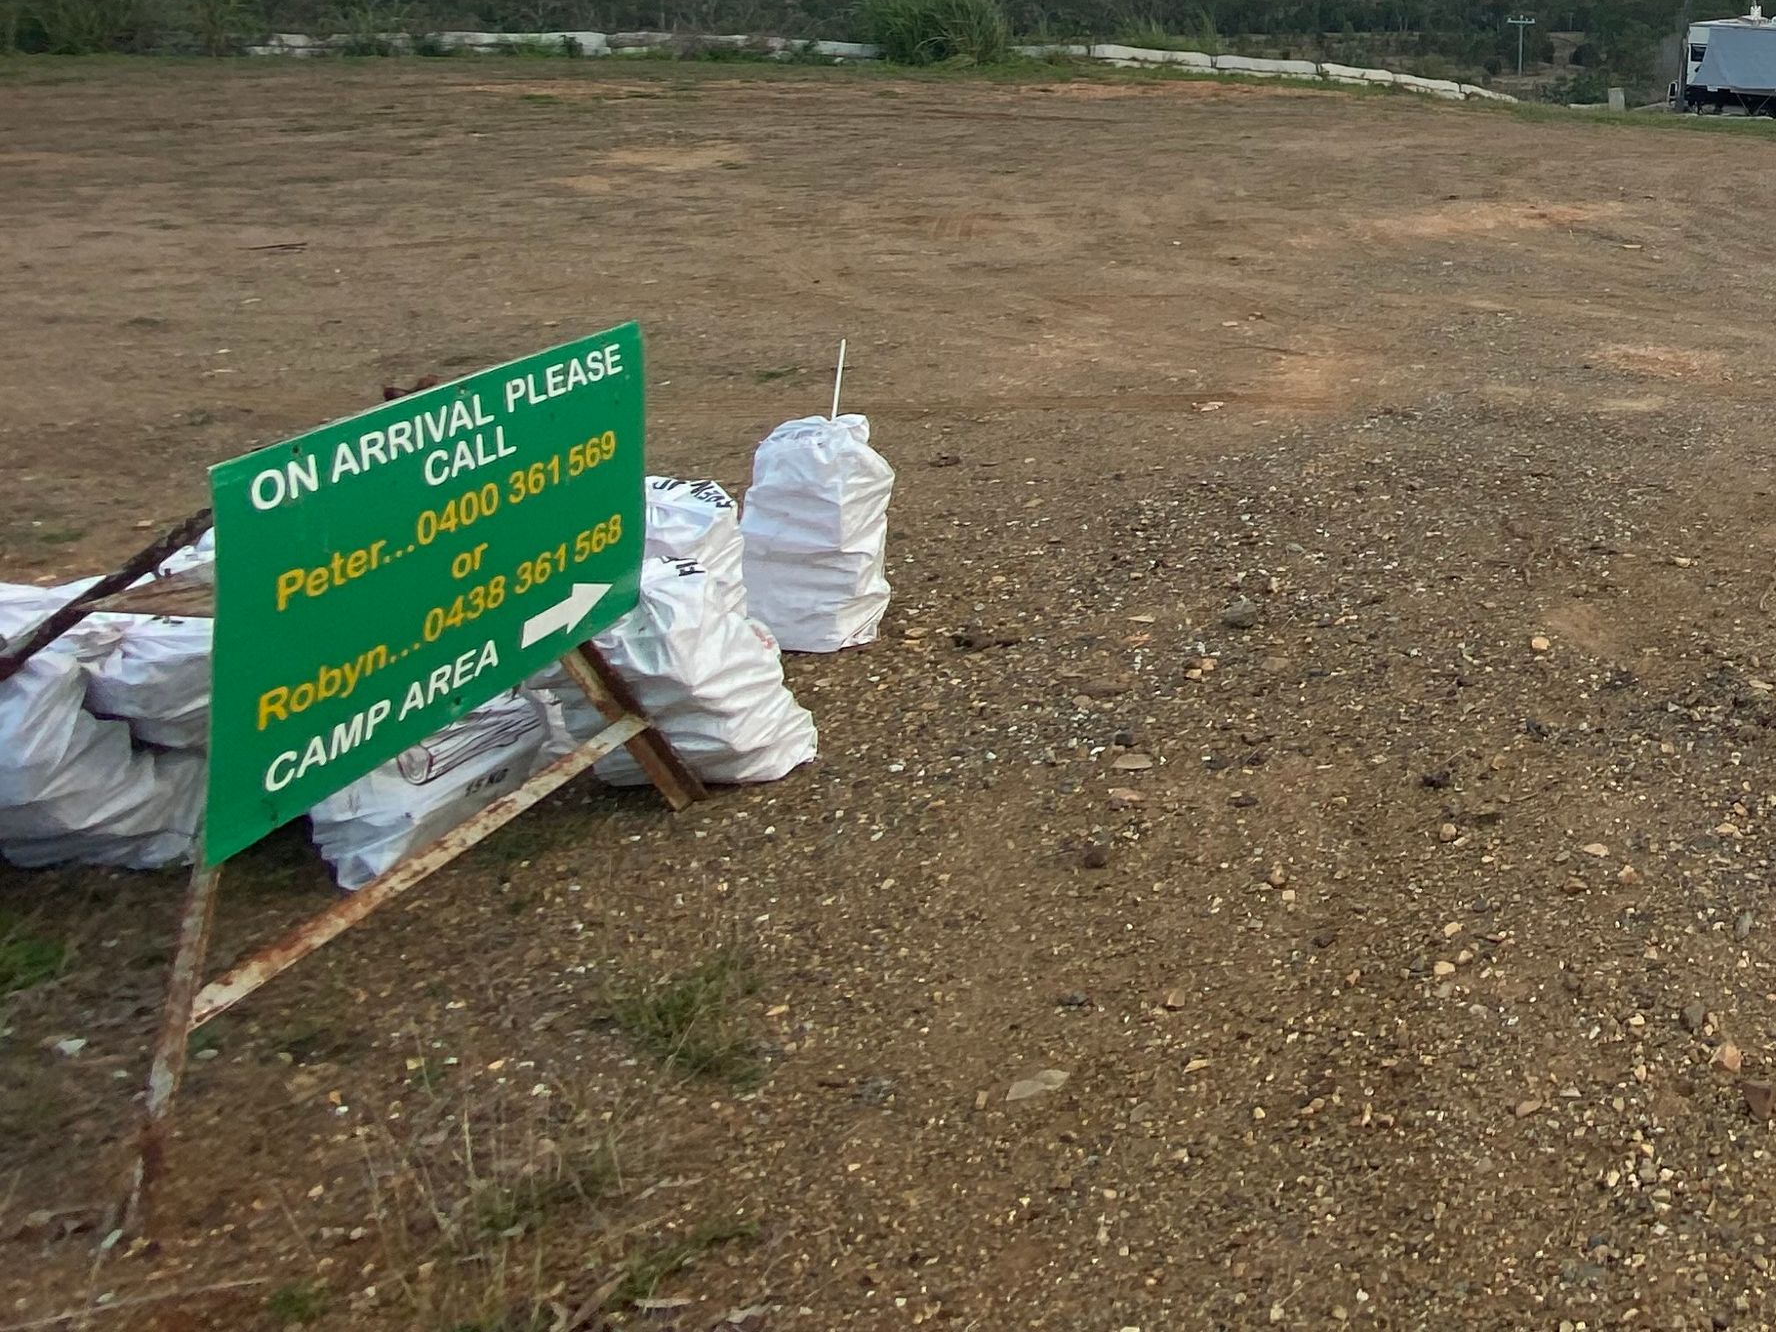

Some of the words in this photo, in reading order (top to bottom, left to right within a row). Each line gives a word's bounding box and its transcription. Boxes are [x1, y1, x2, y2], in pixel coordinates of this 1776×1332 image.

[251, 453, 320, 511] ON
[331, 394, 495, 484] ARRIVAL
[505, 343, 624, 413] PLEASE
[424, 425, 518, 486] CALL
[508, 454, 561, 504] 361
[567, 430, 617, 477] 569
[451, 542, 489, 579] or
[513, 542, 568, 595] 361
[573, 513, 623, 563] 568
[265, 699, 392, 793] CAMP
[399, 639, 500, 722] AREA
